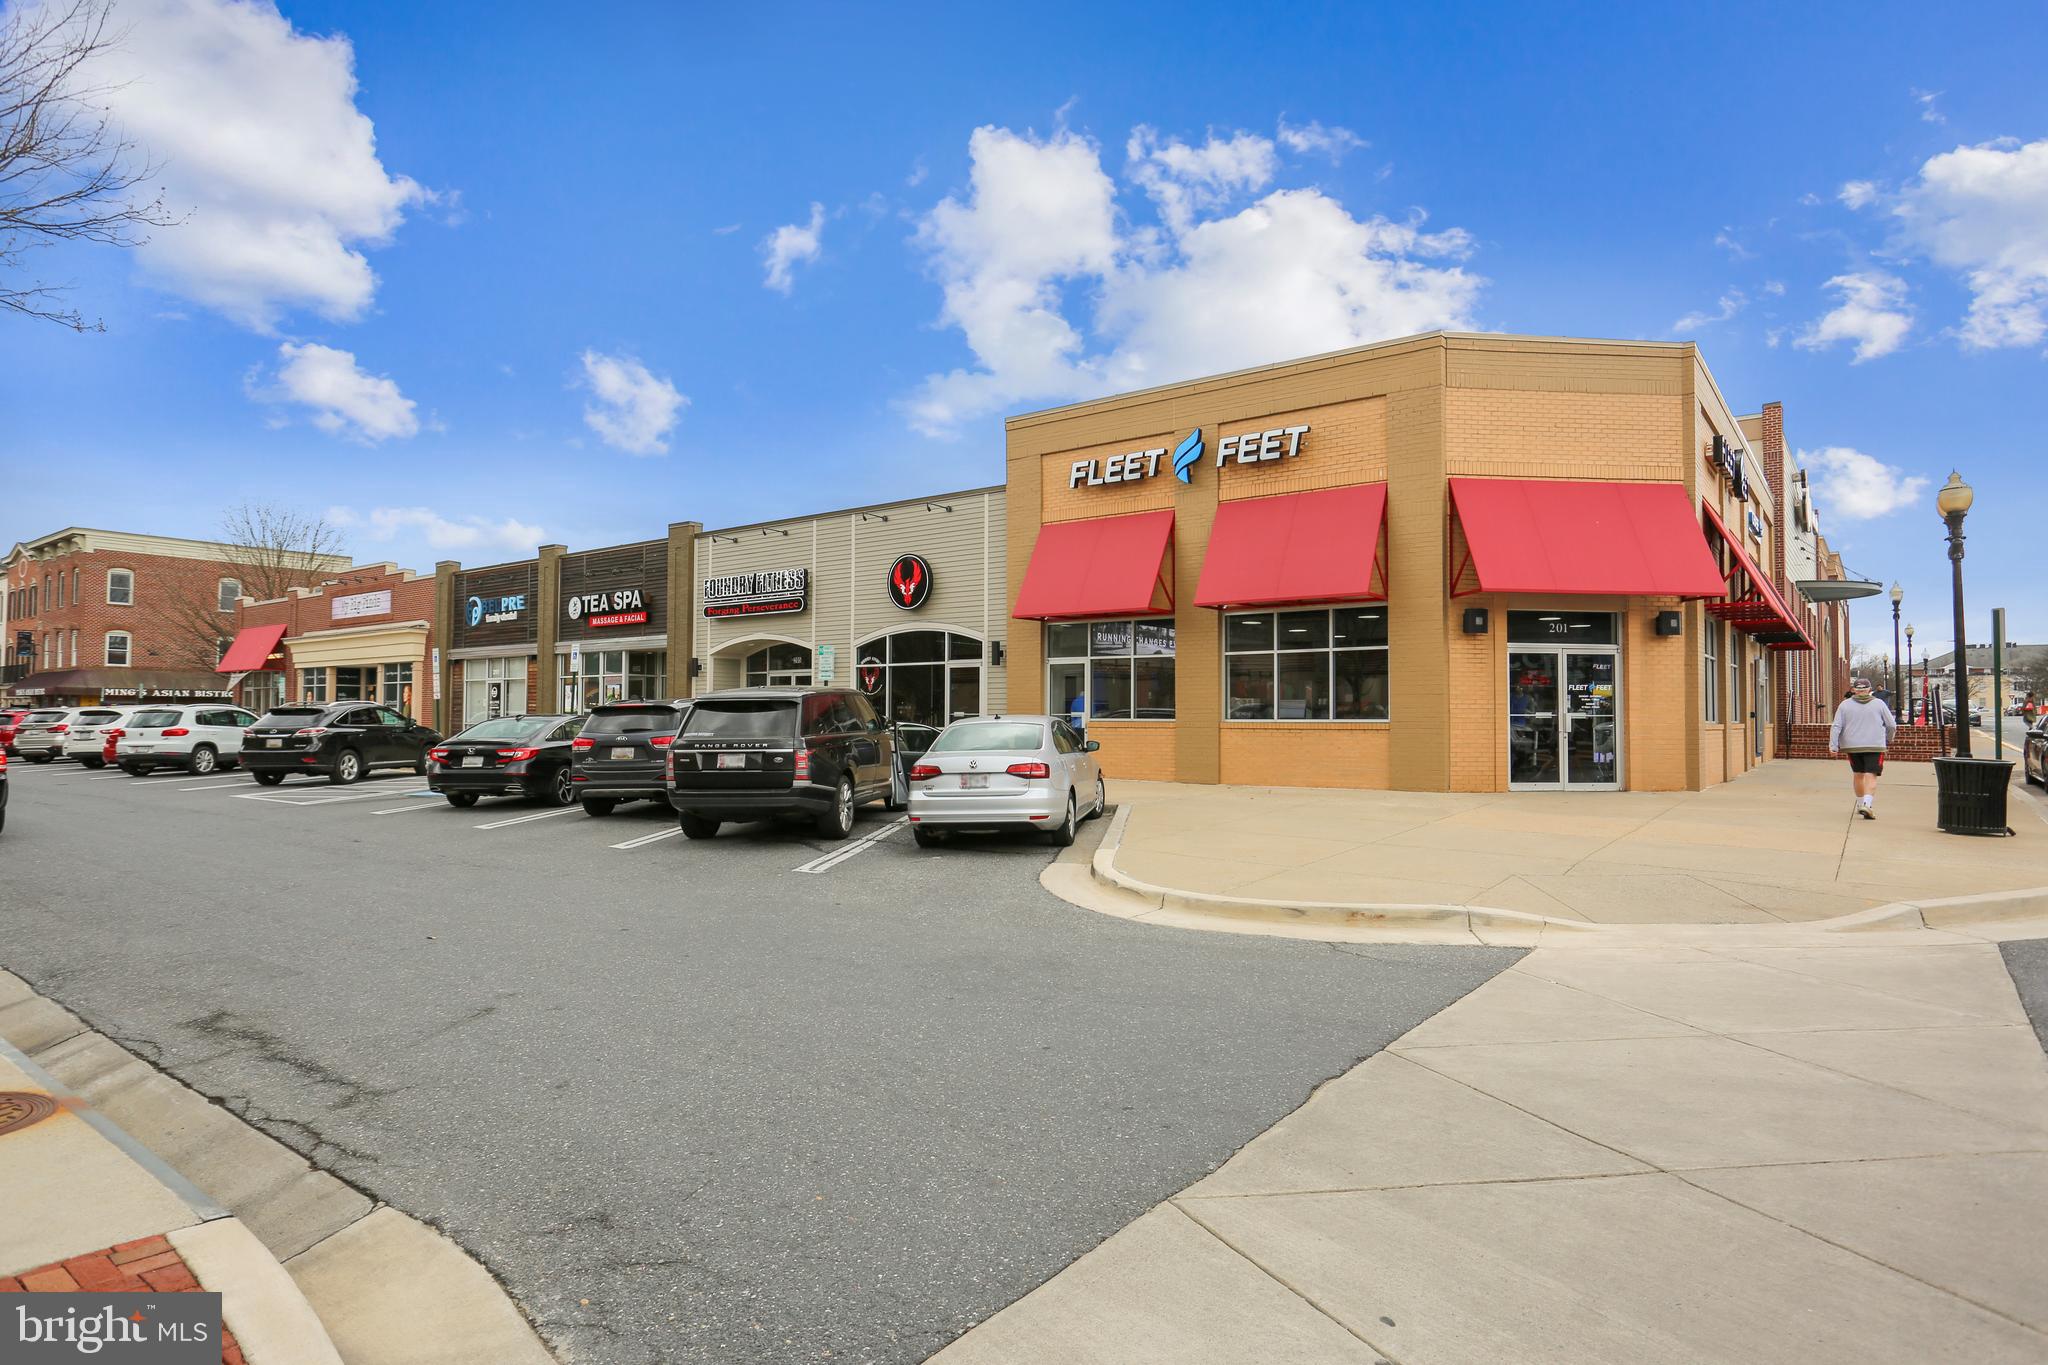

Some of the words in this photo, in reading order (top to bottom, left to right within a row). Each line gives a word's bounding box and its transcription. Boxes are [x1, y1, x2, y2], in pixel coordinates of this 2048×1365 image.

[1069, 448, 1166, 488] FLEET
[1216, 425, 1310, 467] FEET
[704, 574, 754, 599] FOUNDRY
[756, 568, 804, 594] FITNESS
[581, 594, 609, 613] TEA
[613, 590, 642, 610] SPA
[707, 606, 740, 616] Forging
[742, 601, 799, 613] Perseverance
[592, 616, 619, 625] MASSAGE
[624, 614, 644, 622] FACIAL
[1549, 623, 1568, 633] 201
[1097, 632, 1132, 643] RUNNING
[152, 689, 190, 697] ASIAN
